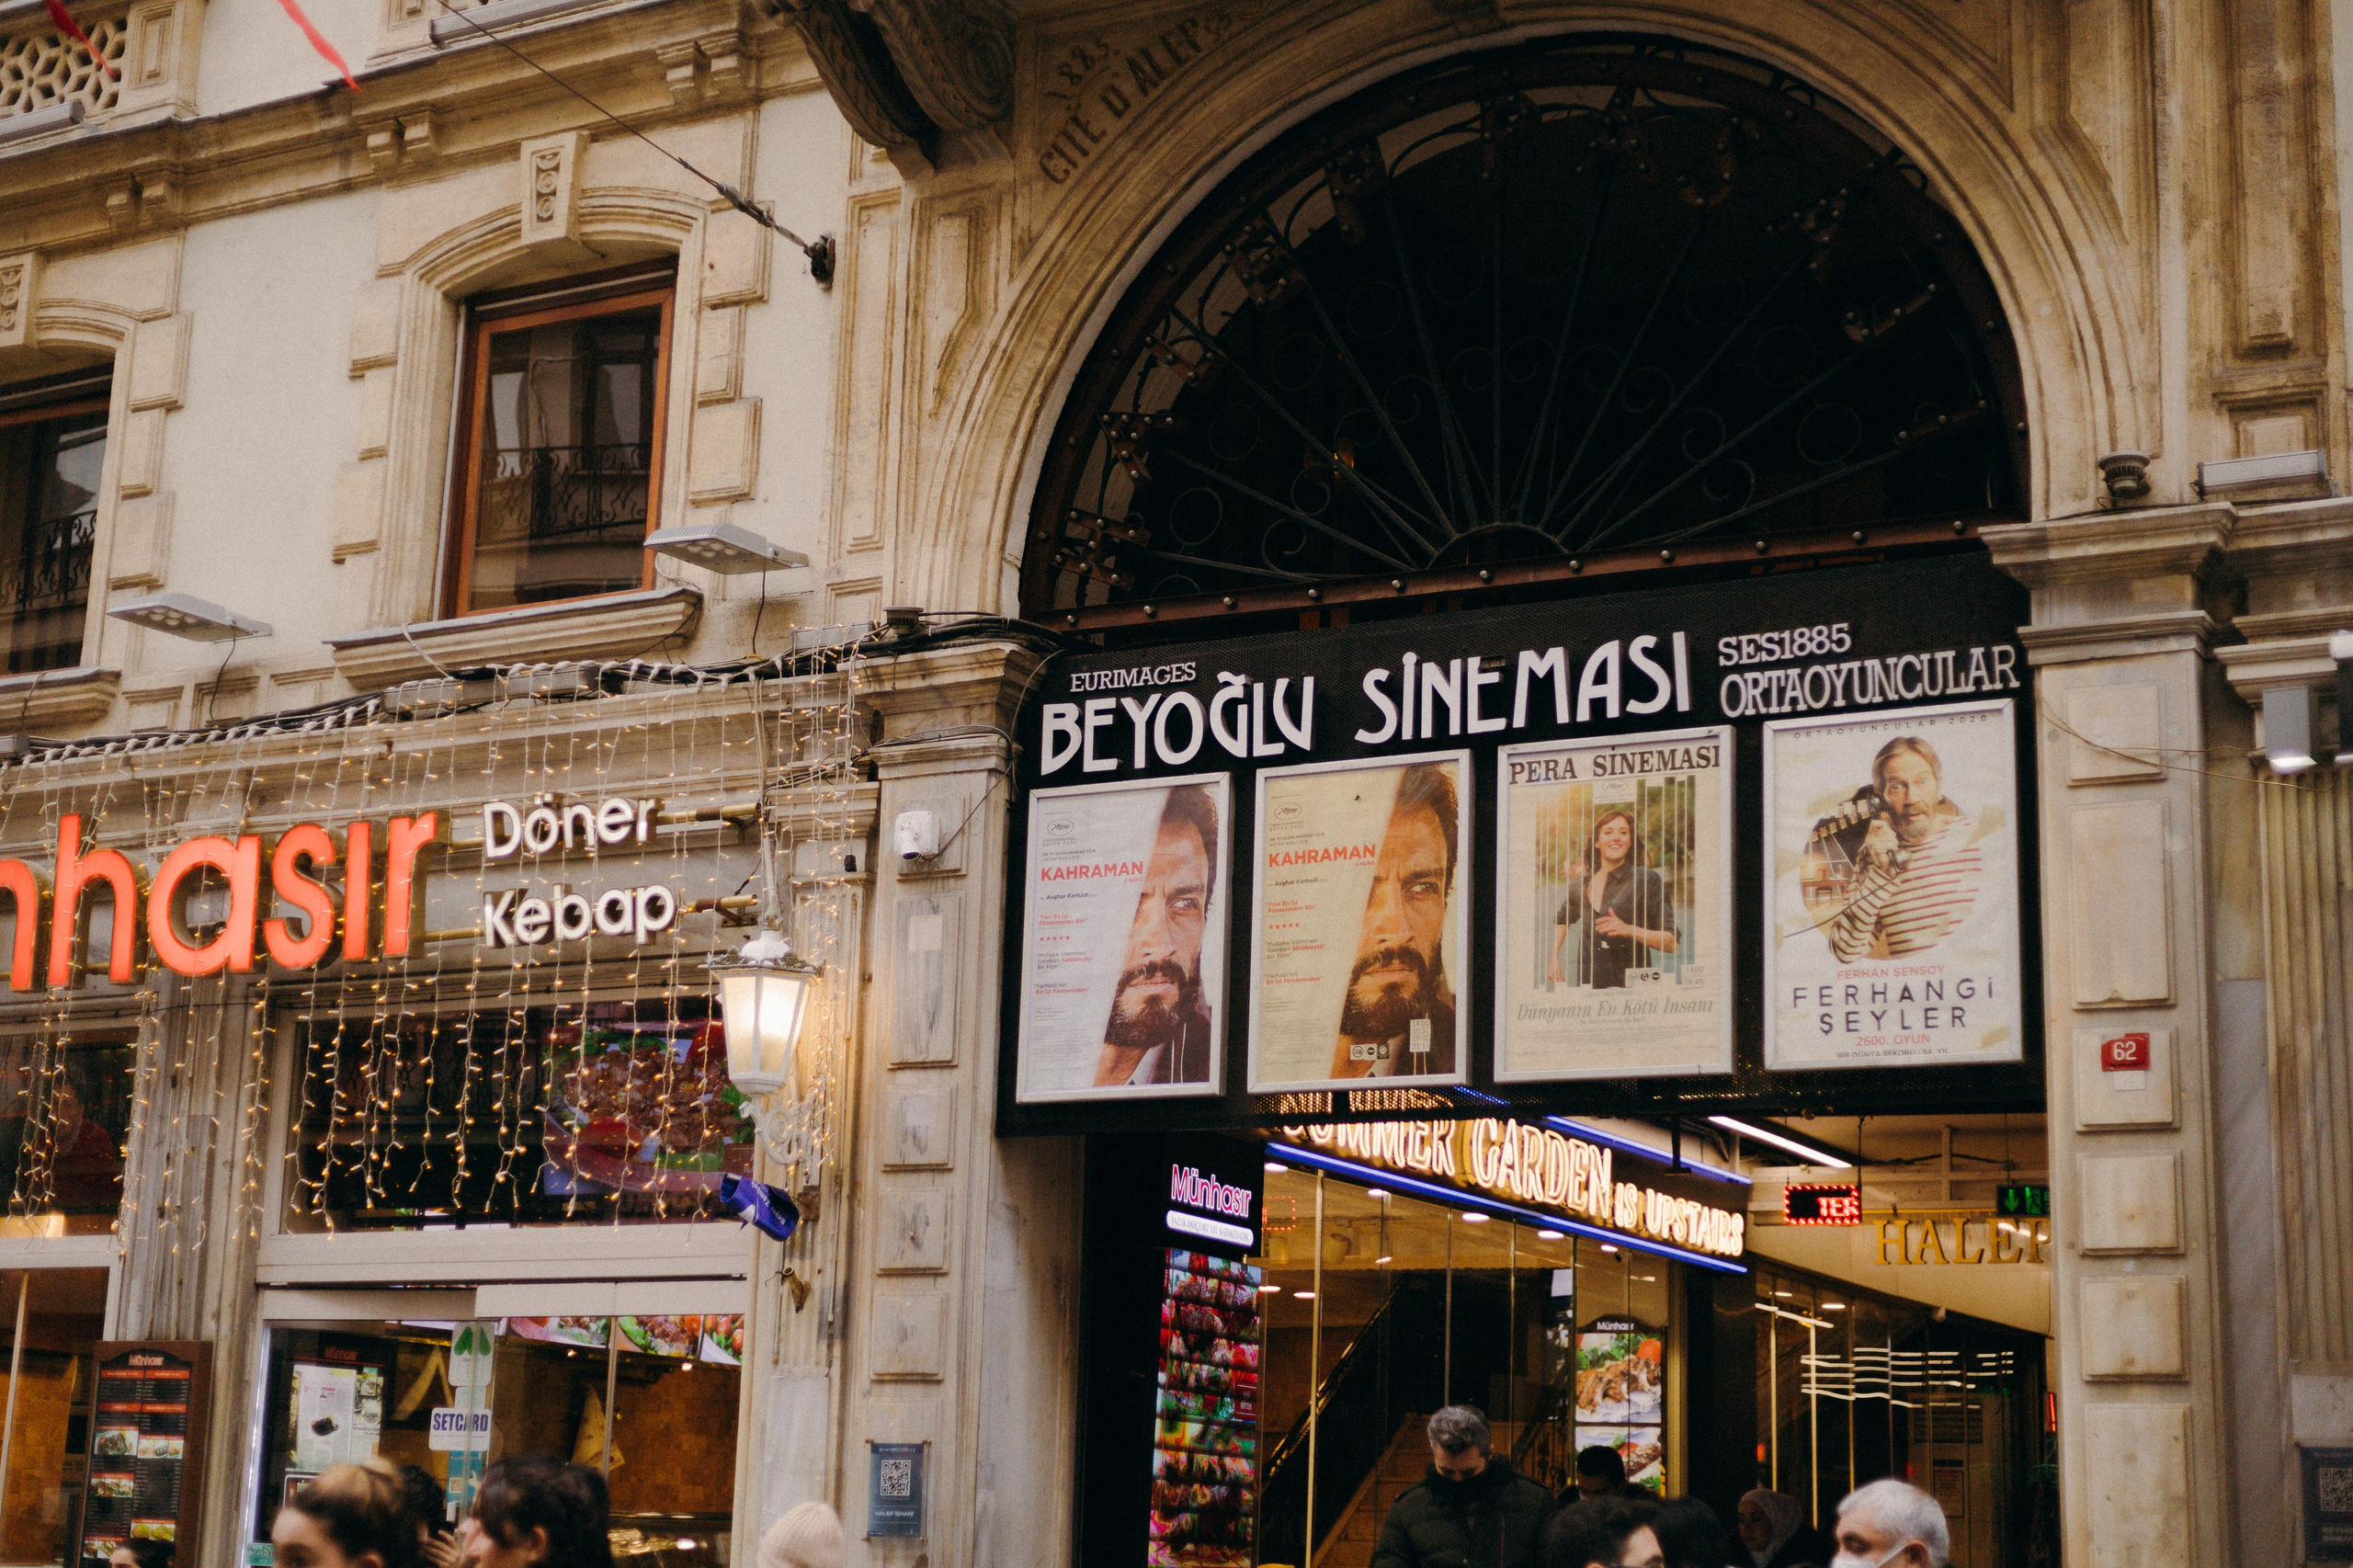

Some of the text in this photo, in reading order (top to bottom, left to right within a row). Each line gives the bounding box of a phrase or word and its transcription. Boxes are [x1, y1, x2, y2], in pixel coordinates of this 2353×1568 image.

[1718, 622, 1852, 666] SES1885
[1070, 662, 1196, 692] EURIMAGES
[1720, 644, 2020, 718] ORTAOYUNCULAR
[1040, 631, 1693, 776] BEYOĞLU SİNEMASI
[1793, 714, 1987, 739] ORTAOYUNCULAR 2020
[1509, 745, 1720, 784] PERA SİNEMASI
[484, 799, 656, 858] Döner
[1040, 860, 1143, 881] KAHRAMAN
[1268, 844, 1376, 868] KAHRAMAN
[1275, 879, 1295, 887] Asghar
[484, 883, 676, 948] Kebap
[1837, 965, 1945, 980] FERHAN ŞENSOY
[1793, 977, 1993, 1008] FERHANGİ
[1516, 994, 1713, 1024] Dünyanın En Kötü İnsanı
[1820, 1006, 1966, 1036] ŞEYLER
[1837, 1051, 1849, 1059] BİR
[1851, 1049, 1881, 1058] DÜNYA
[1857, 1034, 1930, 1047] 2600. OYUN
[2114, 1041, 2137, 1061] 62
[751, 1179, 770, 1208] Zambak
[1171, 1164, 1252, 1218] Münhasır
[1471, 1118, 1612, 1220] GARDEN
[1646, 1187, 1745, 1257] UPSTAIRS
[1597, 1322, 1634, 1331] Münhasr
